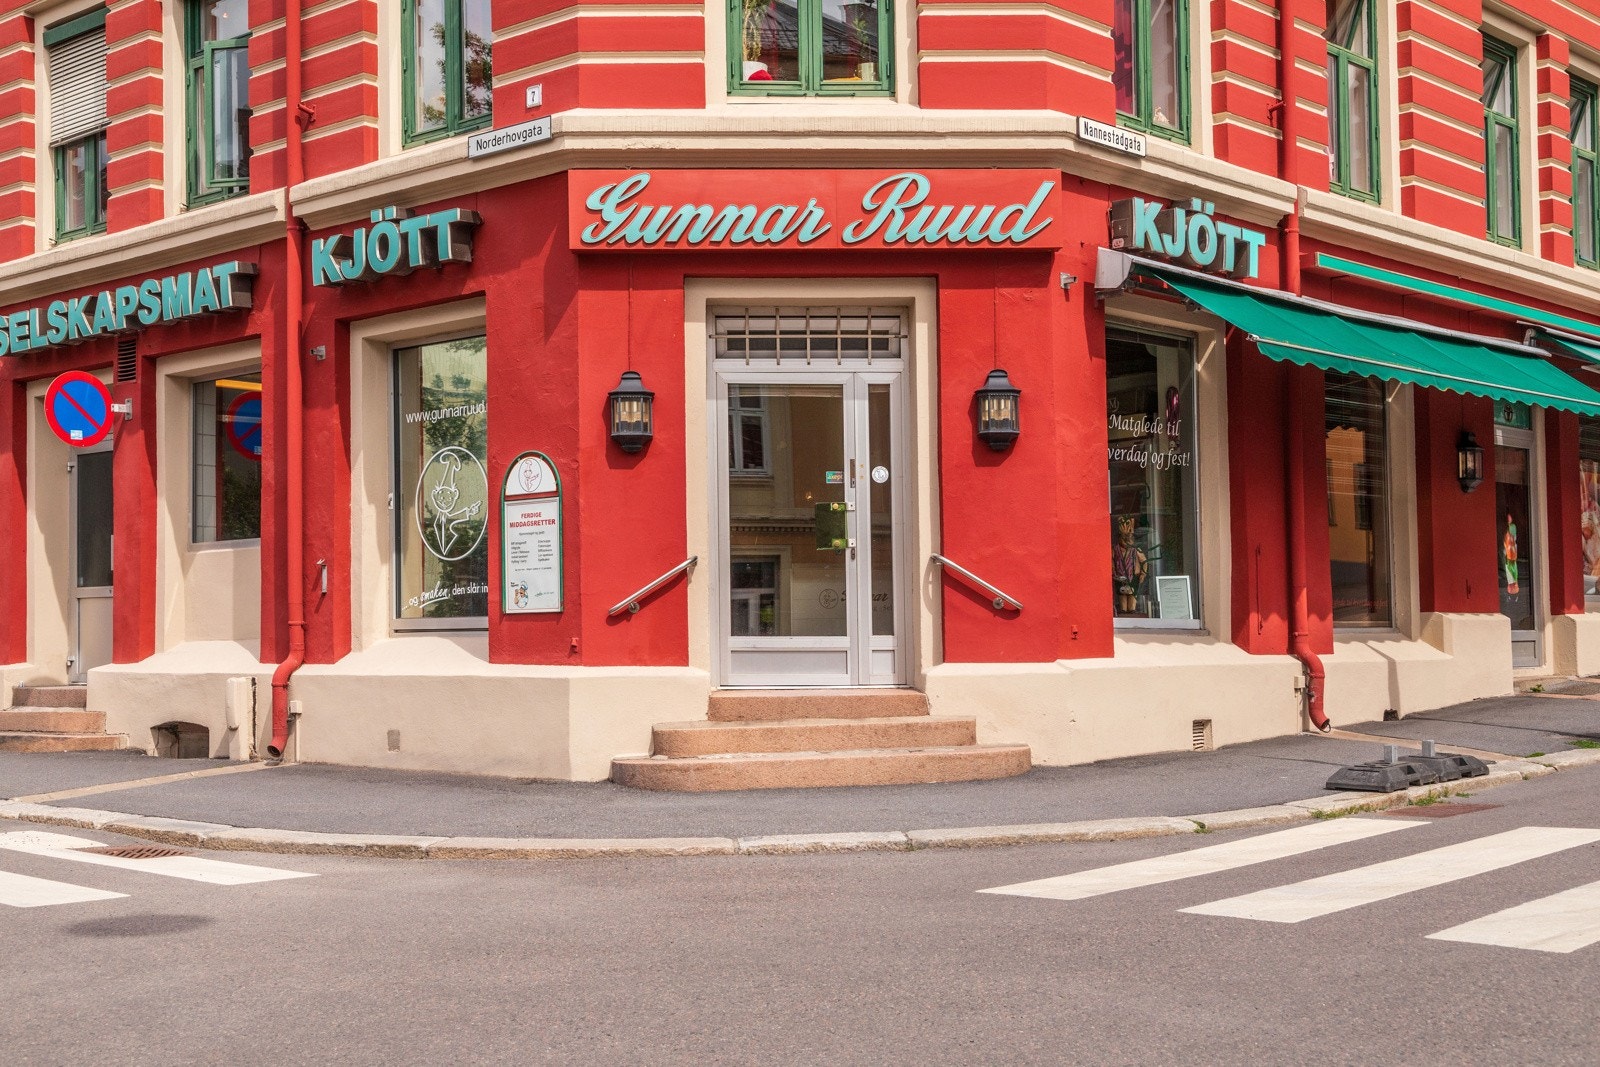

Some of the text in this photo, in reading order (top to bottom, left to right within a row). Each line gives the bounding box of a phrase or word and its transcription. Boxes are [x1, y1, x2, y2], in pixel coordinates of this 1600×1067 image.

[531, 90, 536, 102] 7
[476, 125, 543, 151] Norderhovgata
[1083, 120, 1141, 152] Nannestadgata
[581, 172, 1056, 244] Gunnar Ruud
[312, 205, 461, 286] KJÖTT
[1132, 197, 1266, 278] KJÖTT
[405, 400, 488, 424] www.gunnarruud.
[1108, 414, 1181, 438] Matglede til
[1151, 452, 1164, 470] og
[1165, 448, 1190, 471] fest!
[509, 519, 556, 528] MIDDAGSRETTER
[521, 511, 542, 519] FERDIGE
[452, 583, 465, 596] den
[467, 581, 480, 594] slår
